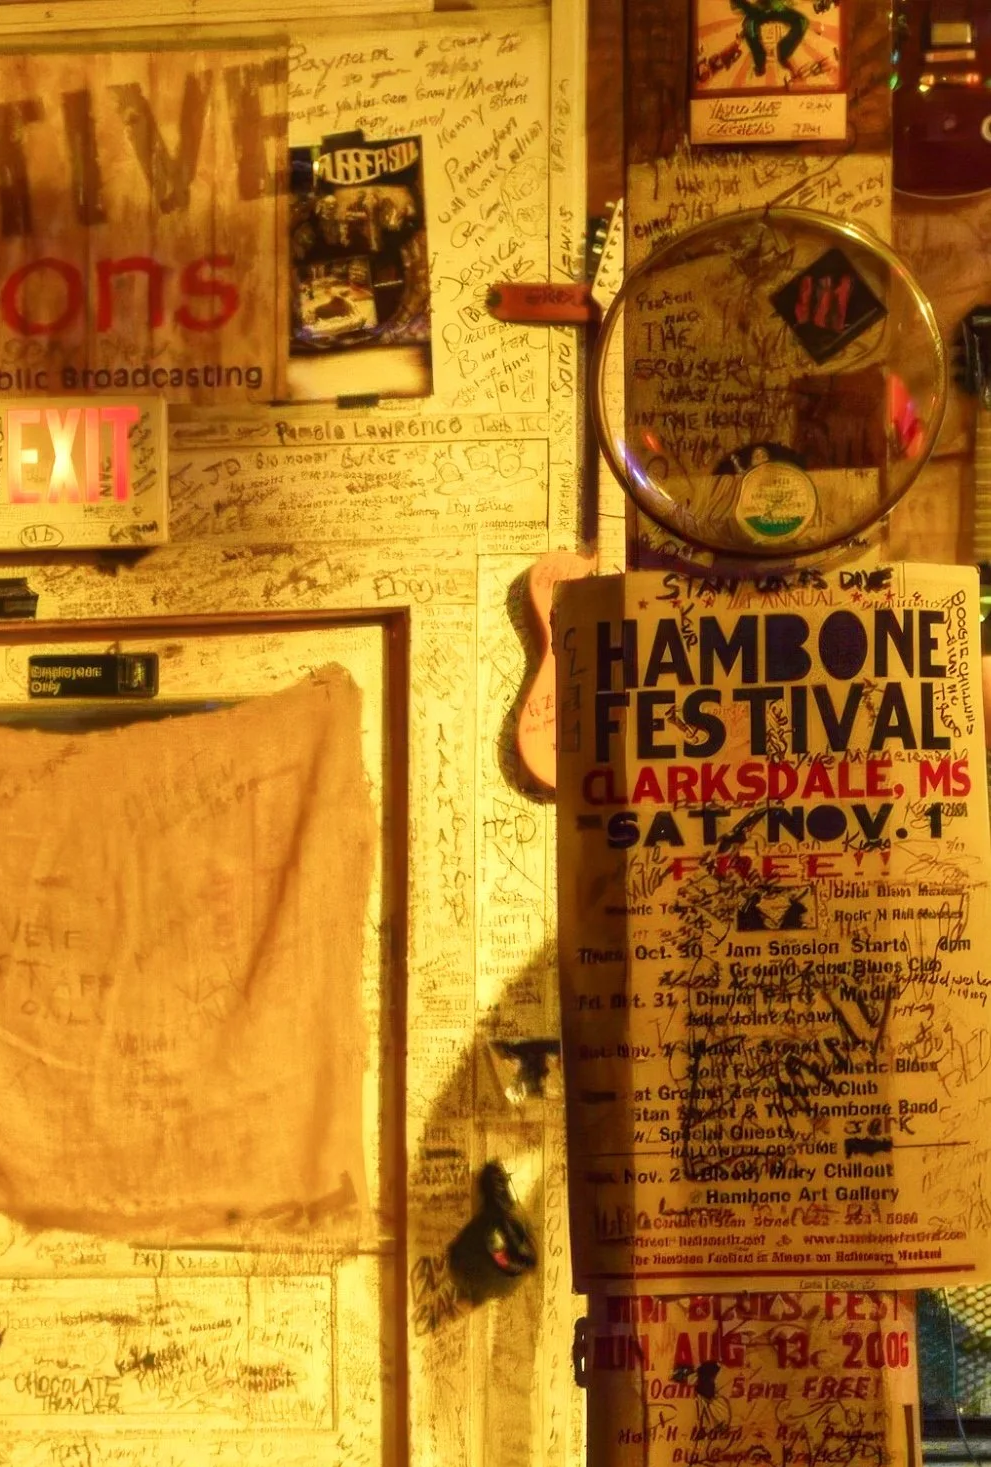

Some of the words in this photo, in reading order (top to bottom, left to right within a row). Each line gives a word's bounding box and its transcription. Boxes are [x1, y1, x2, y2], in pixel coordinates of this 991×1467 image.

[61, 362, 264, 391] Broadcasting
[6, 405, 140, 505] EXIT
[595, 609, 948, 691] HAMBONE
[595, 681, 952, 763] FESTIVAL
[583, 759, 905, 808] CLARKSDALE,
[920, 757, 972, 798] MS
[767, 803, 909, 843] NOV.
[924, 801, 944, 839] 1
[635, 945, 673, 961] Oct.
[726, 943, 761, 958] Jam
[769, 940, 839, 956] Session
[839, 1080, 878, 1096] Club
[809, 1100, 892, 1118] Hambone
[898, 1099, 939, 1115] Band
[623, 1167, 664, 1185] Nov.
[824, 1162, 894, 1179] Chillout
[706, 1188, 791, 1206] Hambone
[798, 1187, 829, 1203] Art
[835, 1185, 901, 1204] Gallery
[842, 1330, 910, 1369] 2006
[731, 1376, 788, 1401] 5pm
